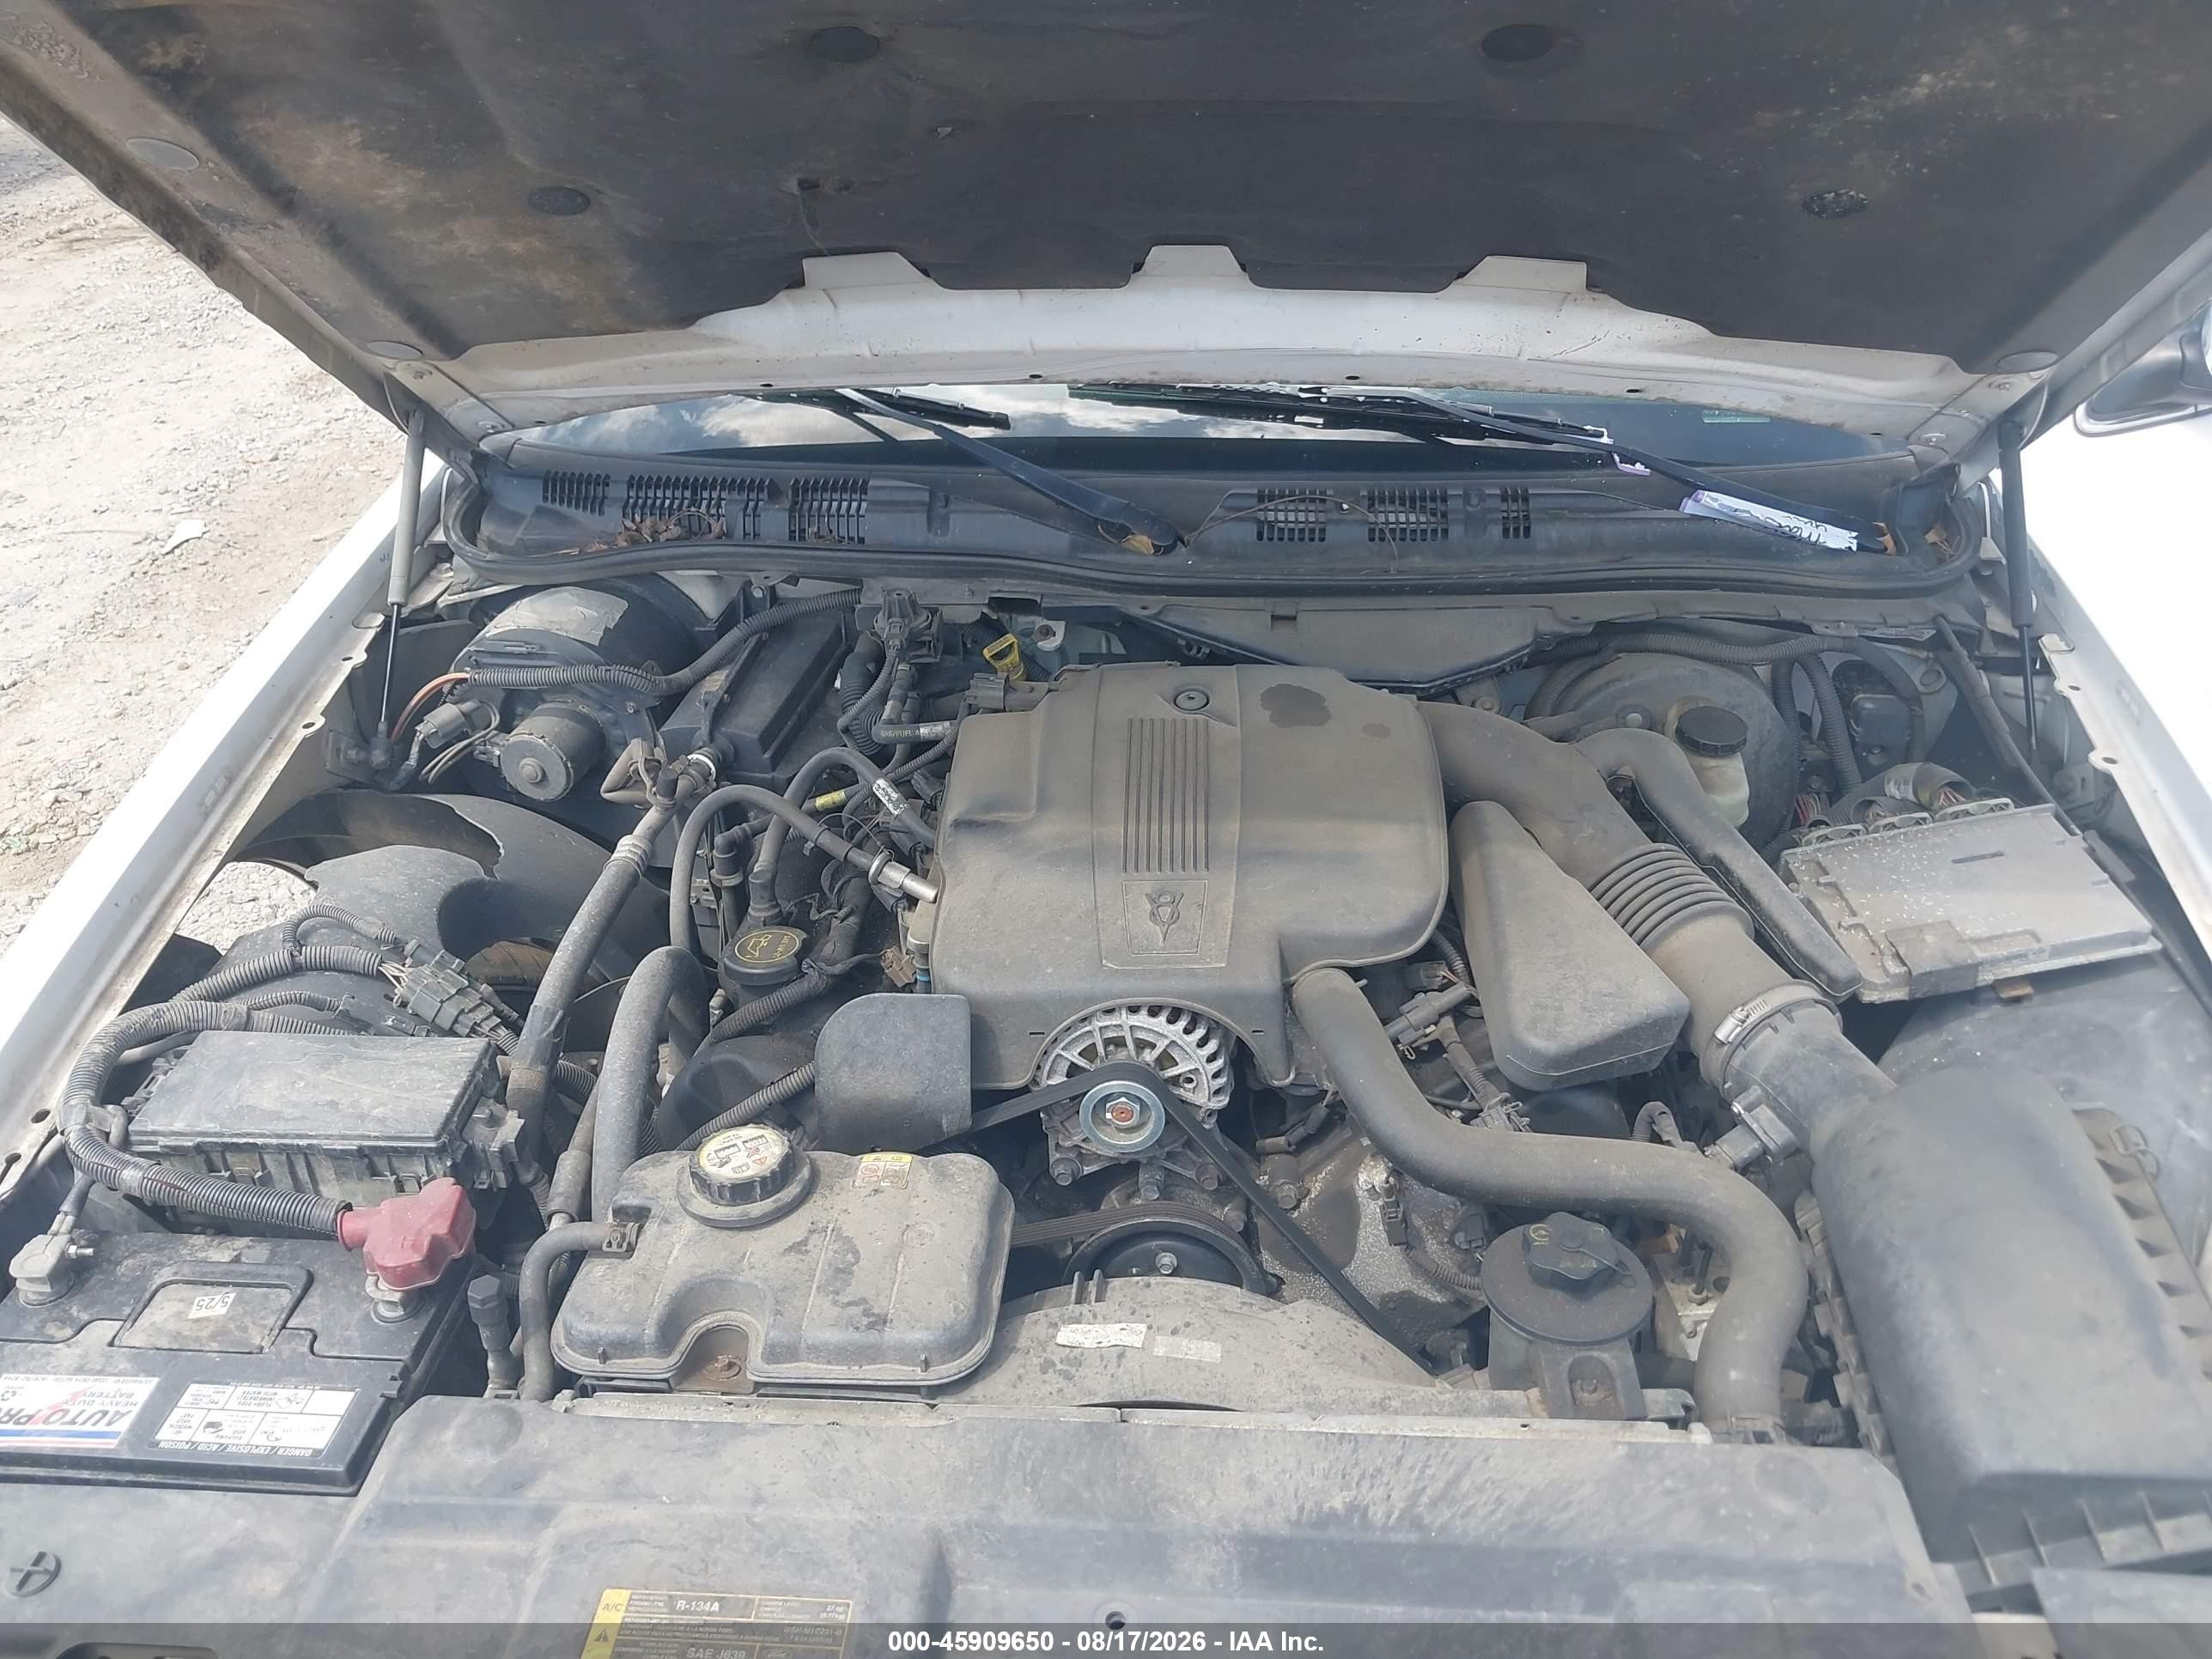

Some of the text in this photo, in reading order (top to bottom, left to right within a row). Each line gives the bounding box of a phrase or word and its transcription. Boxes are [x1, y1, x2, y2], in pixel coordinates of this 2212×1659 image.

[0, 1407, 43, 1426] PR
[157, 1441, 191, 1449] POISON
[198, 1443, 220, 1451] ACID
[225, 1443, 270, 1455] EXPLOSIVE
[276, 1446, 313, 1457] DANGER
[602, 1601, 623, 1613] A/C
[676, 1600, 720, 1613] R-134A
[686, 1647, 714, 1658] SAE
[715, 1648, 746, 1659] J639
